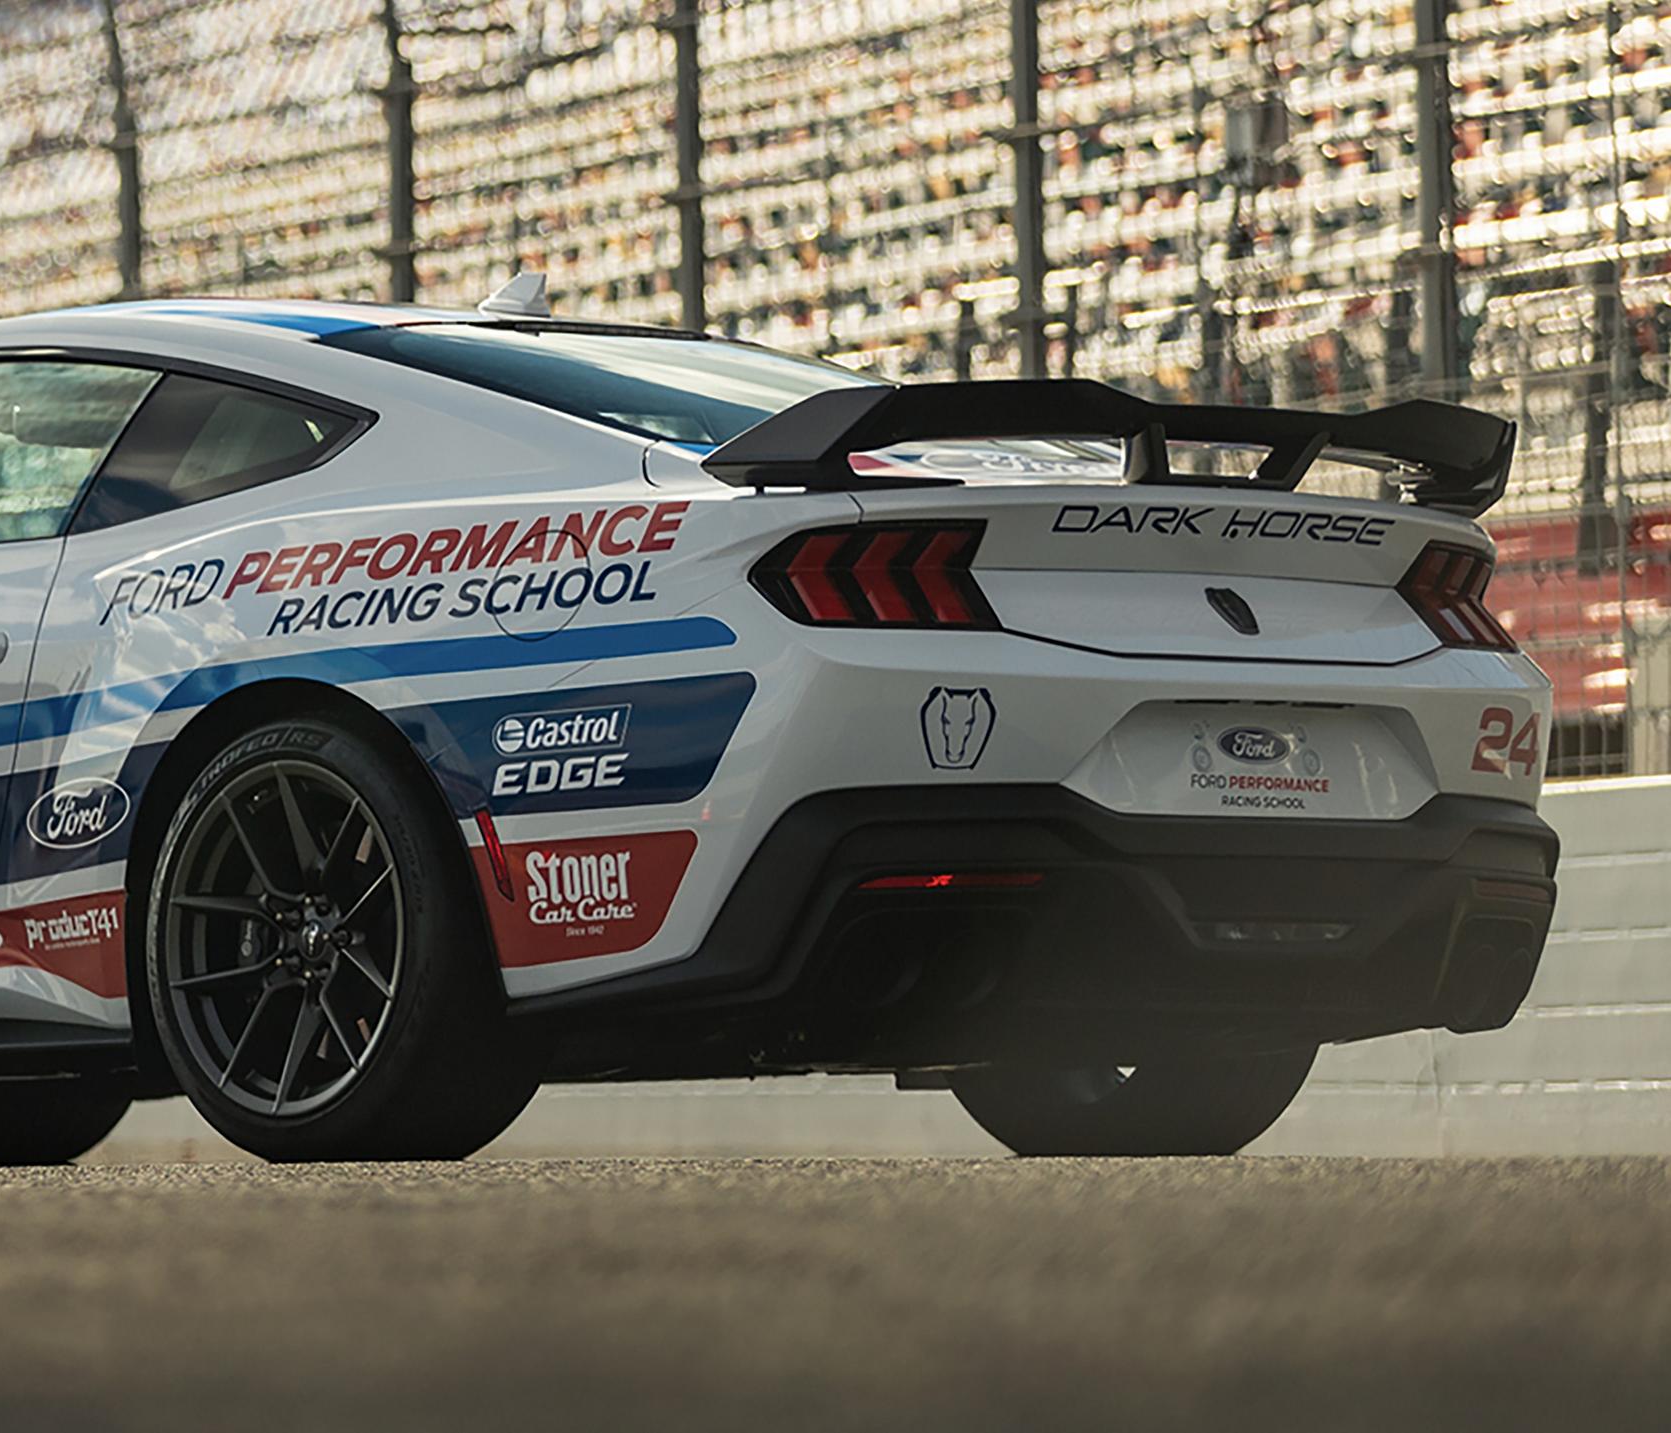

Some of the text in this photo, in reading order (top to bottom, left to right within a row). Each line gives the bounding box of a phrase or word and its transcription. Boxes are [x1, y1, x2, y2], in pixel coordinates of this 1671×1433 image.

[1052, 505, 1396, 545] DARK HORSE
[99, 501, 692, 627] FORD PERFORMANCE
[266, 560, 658, 636] RACING SCHOOL
[525, 711, 620, 750] Castrol
[1232, 732, 1276, 757] Ford
[1470, 706, 1541, 777] 24
[492, 753, 630, 796] EDGE
[1190, 773, 1330, 793] FORD PERFORMANCE
[46, 788, 107, 841] Ford
[1220, 795, 1261, 808] RACING
[525, 850, 631, 904] Stoner
[529, 897, 635, 925] Car Care
